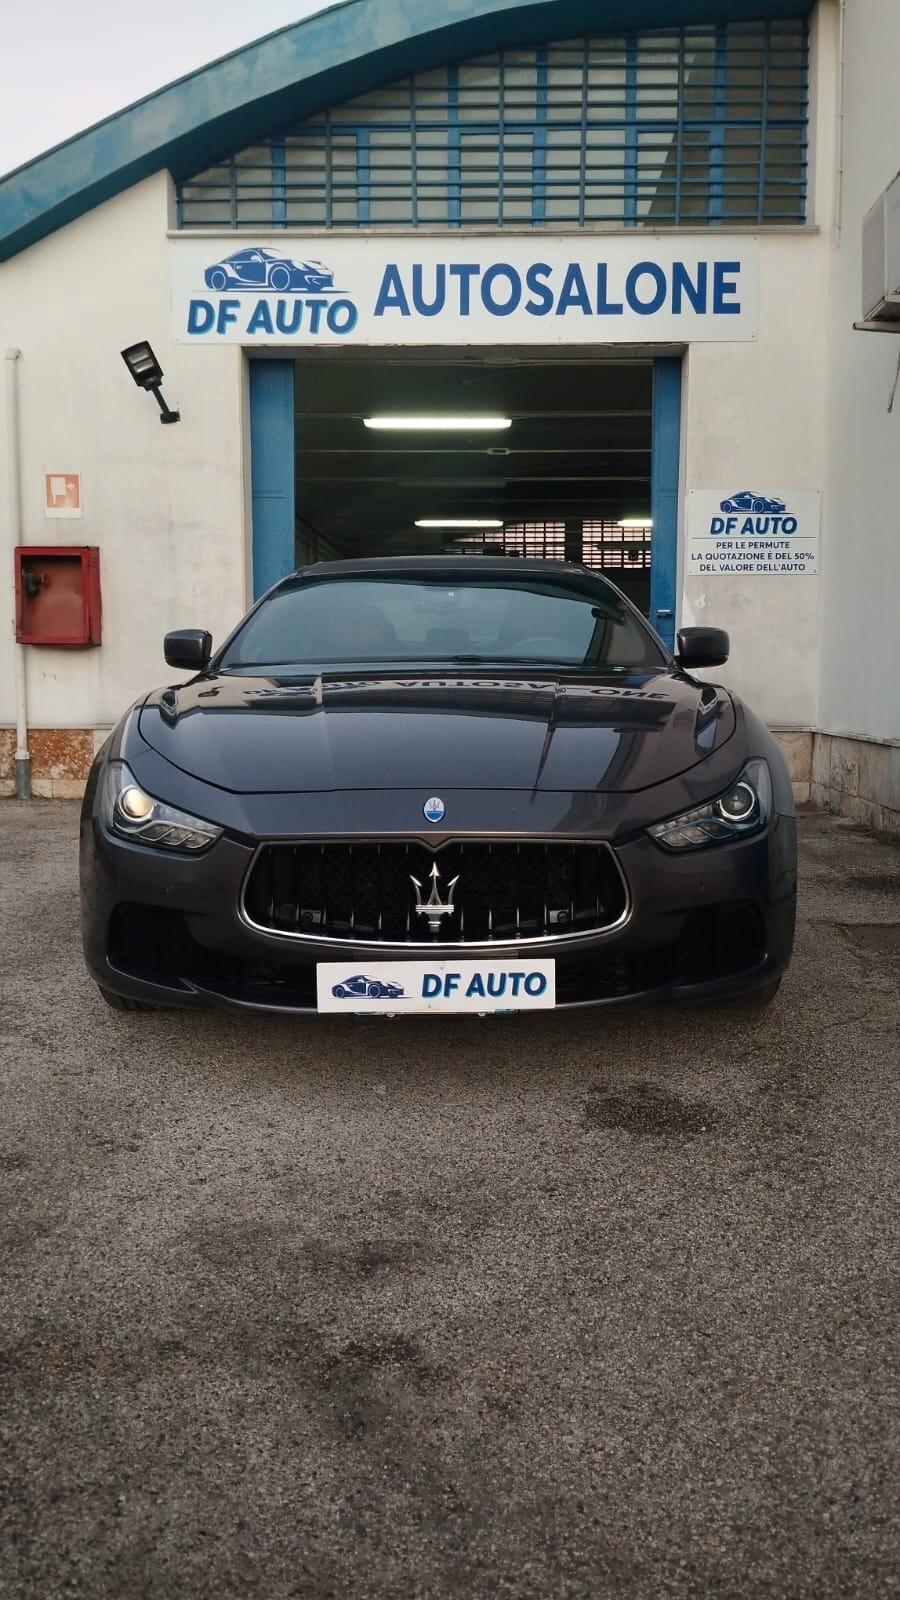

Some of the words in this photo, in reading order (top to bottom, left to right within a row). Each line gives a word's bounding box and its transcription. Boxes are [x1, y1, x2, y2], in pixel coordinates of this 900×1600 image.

[373, 261, 741, 317] AUTOSALONE
[186, 299, 240, 336] DF
[246, 299, 358, 336] AUTO
[710, 517, 738, 535] DF
[740, 517, 798, 535] AUTO
[716, 541, 733, 549] PER
[736, 541, 746, 549] LE
[748, 541, 790, 549] PERMUTE
[691, 553, 703, 561] LA
[705, 552, 765, 561] QUOTAZIONE
[767, 551, 773, 560] È
[775, 552, 792, 560] DEL
[794, 552, 815, 560] 50%
[699, 564, 717, 572] DEL
[719, 564, 754, 572] VALORE
[756, 563, 806, 571] DELL'AUTO
[421, 973, 461, 998] DF
[465, 971, 548, 998] AUTO
